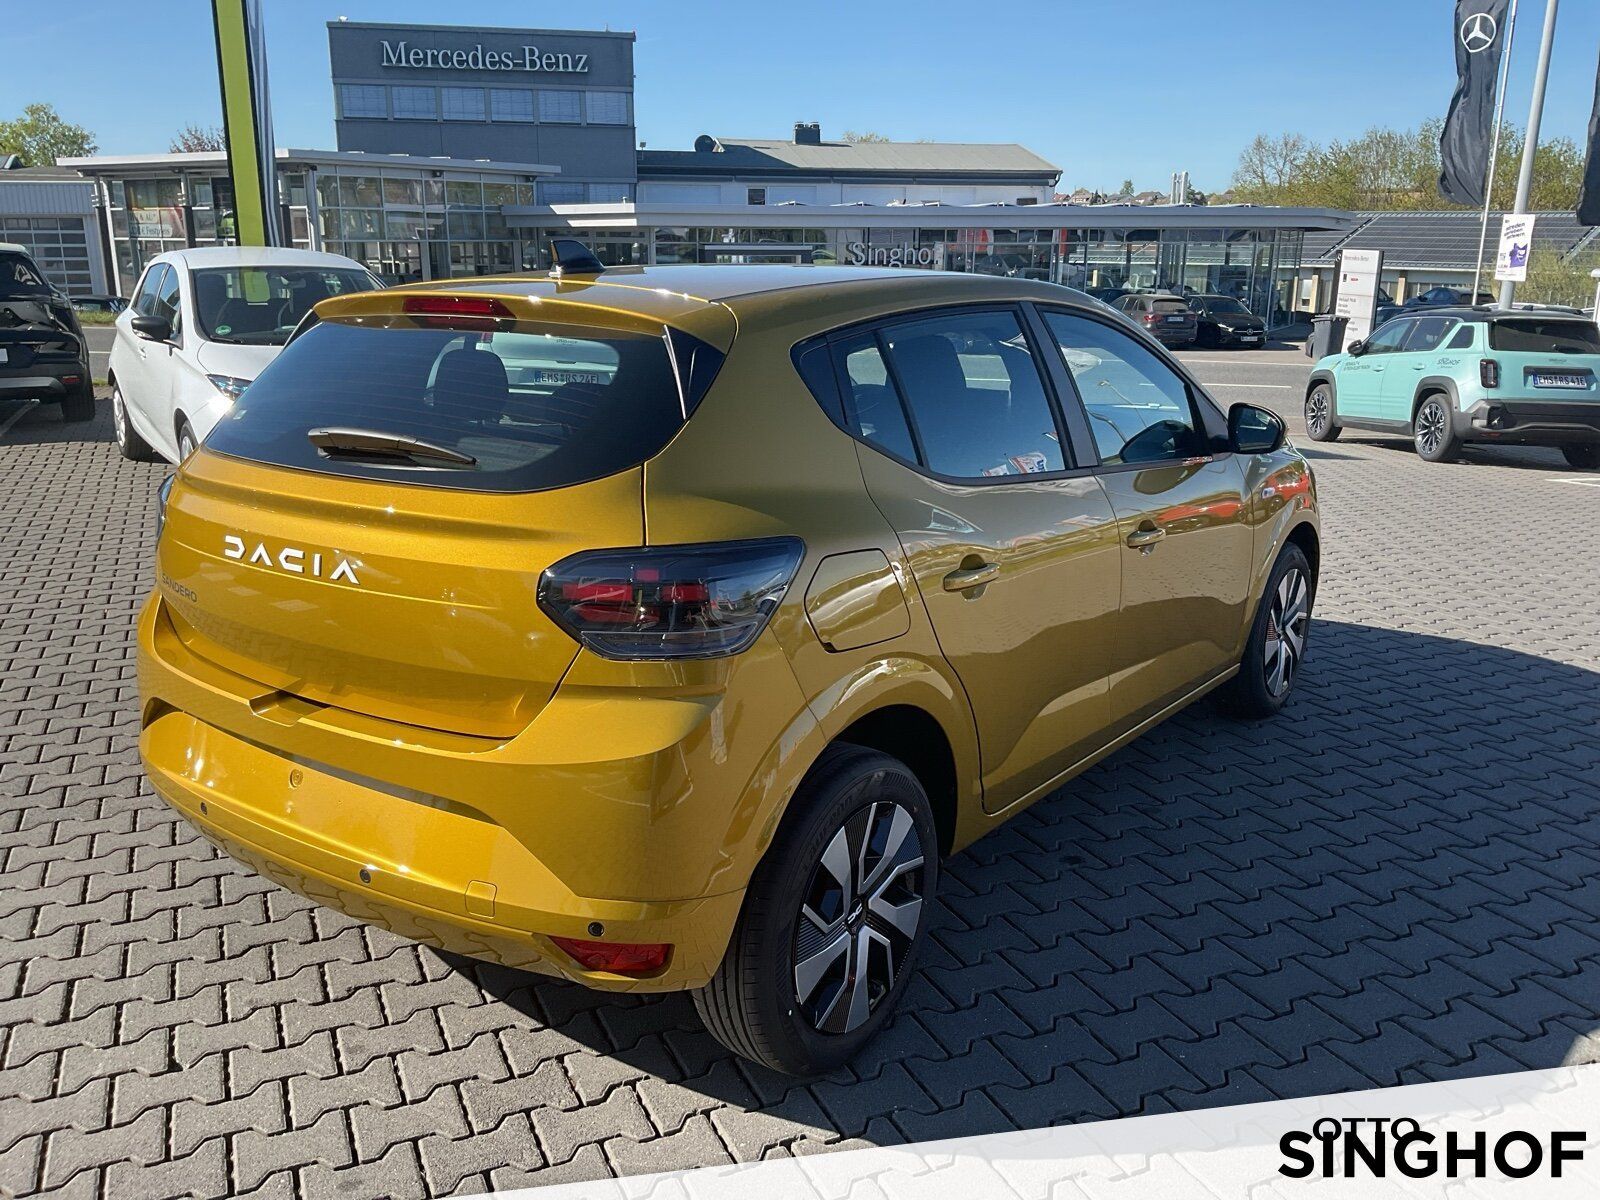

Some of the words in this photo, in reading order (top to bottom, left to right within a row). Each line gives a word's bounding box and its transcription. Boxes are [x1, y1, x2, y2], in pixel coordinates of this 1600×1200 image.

[380, 40, 589, 73] Mercedes-Benz
[224, 535, 361, 585] DACIA
[161, 573, 198, 603] SANDERO
